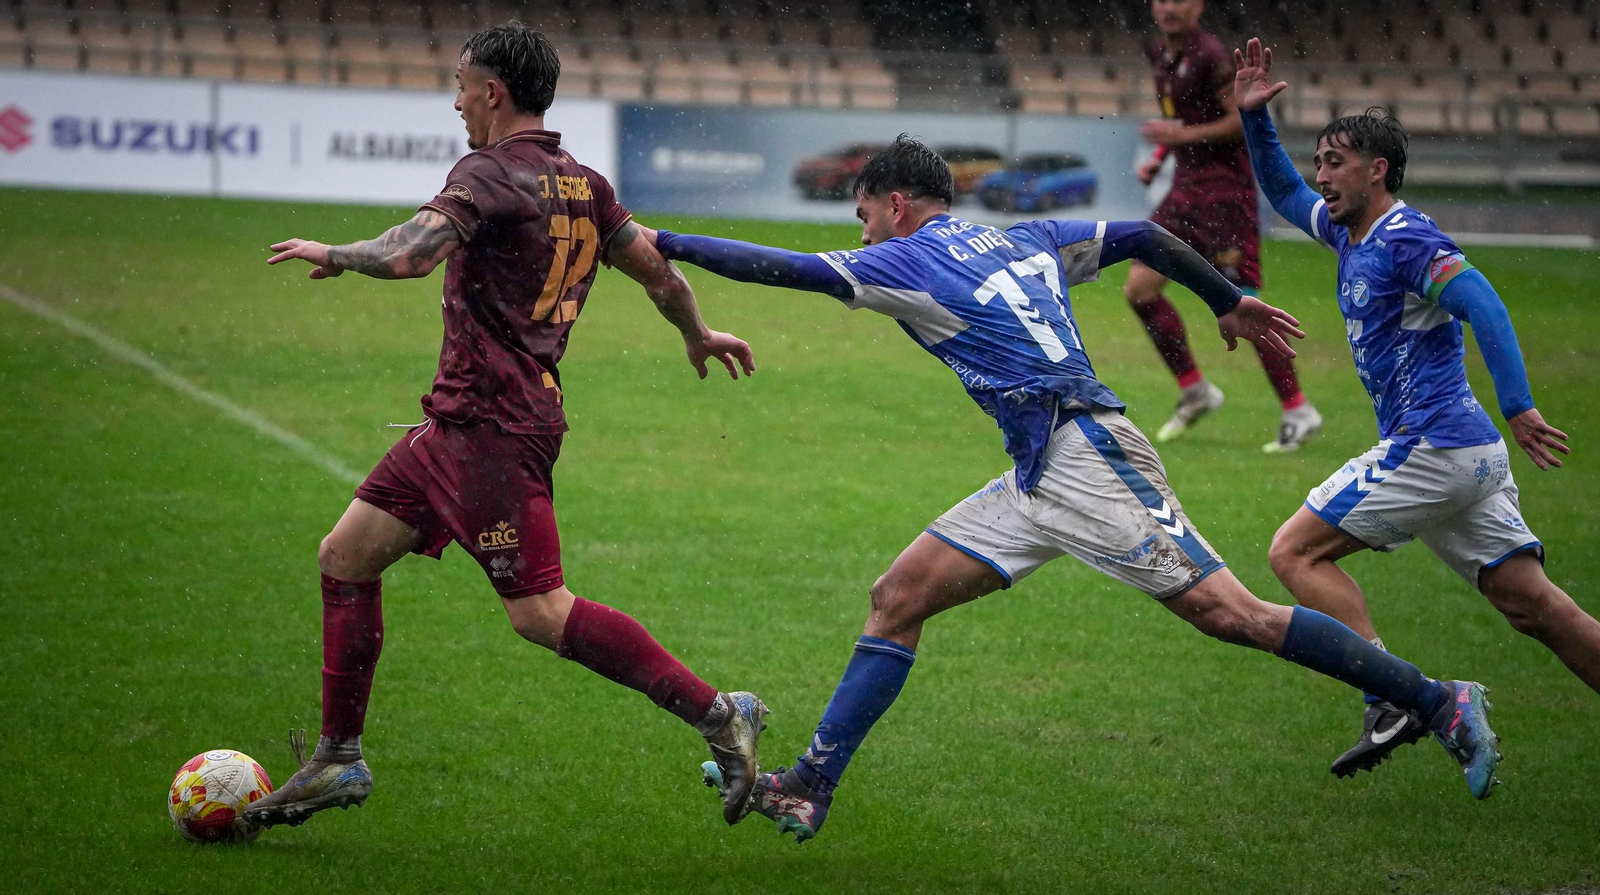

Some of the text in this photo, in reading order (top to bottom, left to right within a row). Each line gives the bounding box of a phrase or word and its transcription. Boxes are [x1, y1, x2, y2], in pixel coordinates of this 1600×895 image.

[51, 117, 261, 156] SUZUKI
[947, 244, 976, 262] C.
[972, 251, 1082, 363] 17
[478, 528, 519, 547] CRC
